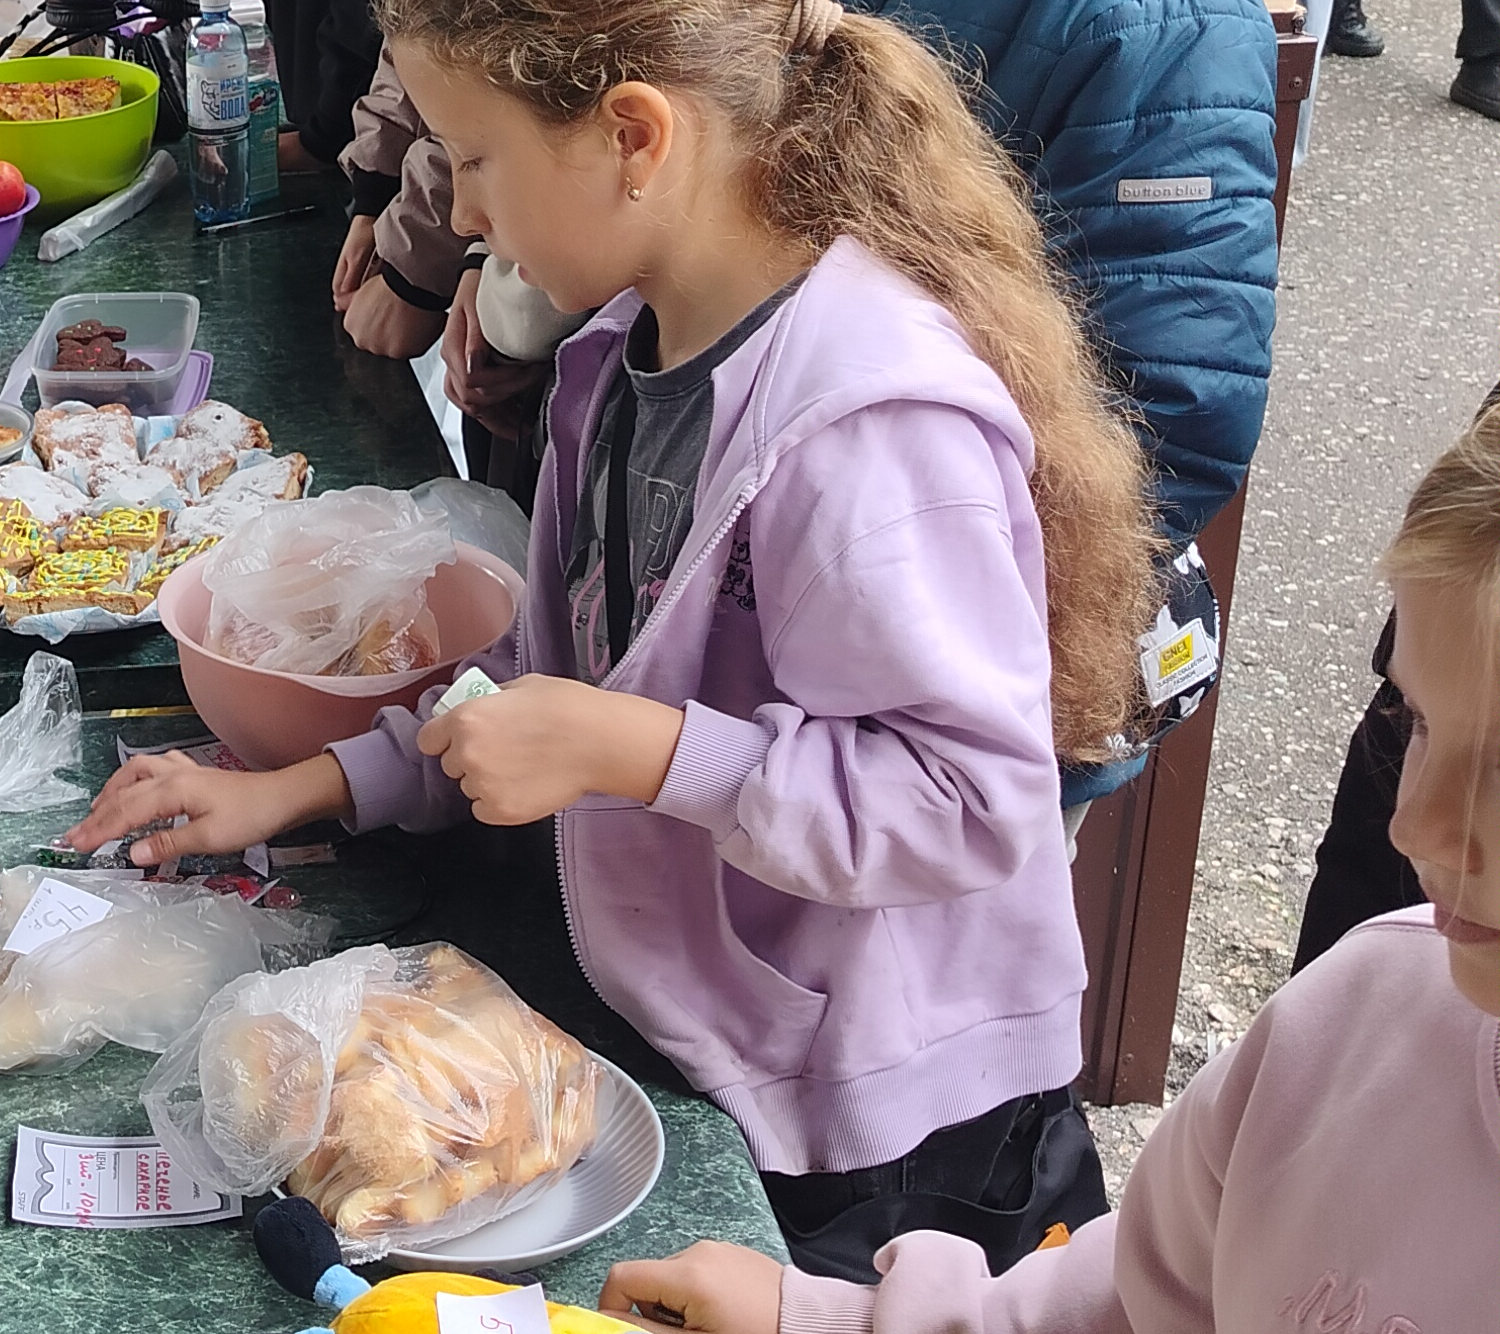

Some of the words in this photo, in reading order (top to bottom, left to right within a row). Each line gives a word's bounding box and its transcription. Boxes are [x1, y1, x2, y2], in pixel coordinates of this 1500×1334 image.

[220, 96, 245, 120] ВОДА
[1121, 183, 1171, 199] button
[1175, 181, 1207, 197] blue
[95, 1151, 107, 1171] ЦЕНА
[17, 1191, 26, 1212] STAFF
